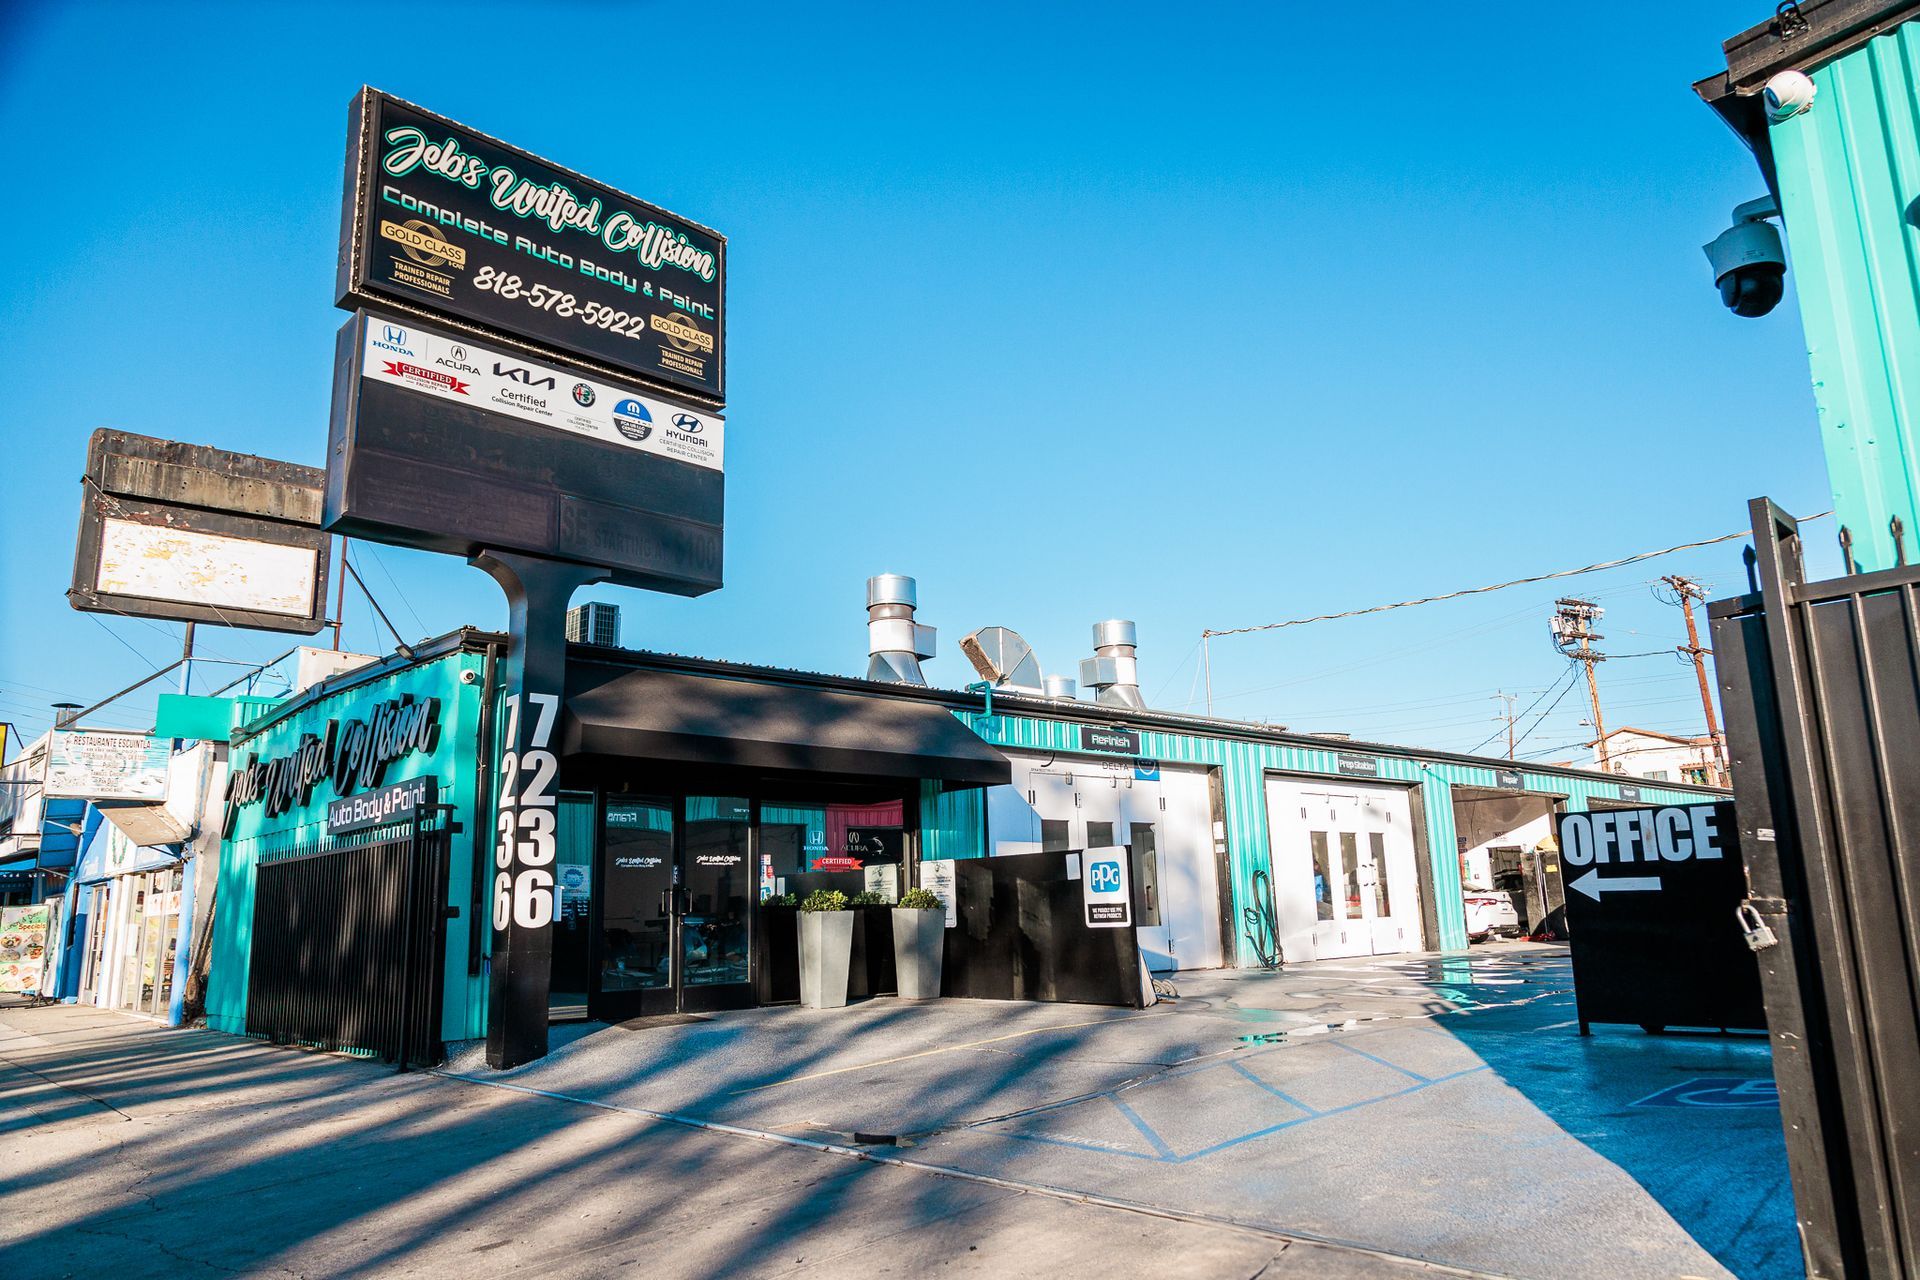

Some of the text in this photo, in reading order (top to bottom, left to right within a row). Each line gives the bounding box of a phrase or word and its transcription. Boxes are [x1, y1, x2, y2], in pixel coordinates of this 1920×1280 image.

[384, 127, 716, 279] Jeb's United Collision
[383, 185, 715, 321] Complete Auto Body & Paint
[385, 225, 463, 261] GOLD CLASS
[393, 270, 451, 295] PROFESSIONALS
[394, 261, 451, 287] TRAINED REPAIR
[472, 265, 646, 340] 818-578-5922
[653, 317, 711, 346] GOLD CLASS
[372, 340, 415, 358] HONDA
[661, 349, 704, 368] TRAINED REPAIR
[401, 364, 453, 385] CERTIFIED
[435, 357, 482, 376] ACURA
[493, 362, 556, 391] KIA
[661, 358, 704, 377] PROFESSIONALS
[491, 396, 553, 418] Collision Repair Center
[500, 387, 547, 408] Certified
[665, 429, 709, 448] HYUNDAI
[666, 446, 708, 462] REPAIR CENTER
[73, 735, 118, 748] RESTAURANTE
[333, 691, 440, 797] Collision
[1091, 734, 1131, 748] Refinish
[1102, 761, 1129, 771] DELTA
[328, 782, 426, 829] Auto Body & Paint
[1561, 805, 1723, 866] OFFICE
[840, 844, 869, 852] ACURA
[821, 857, 853, 865] CERTIFIED
[1091, 864, 1119, 891] PPG
